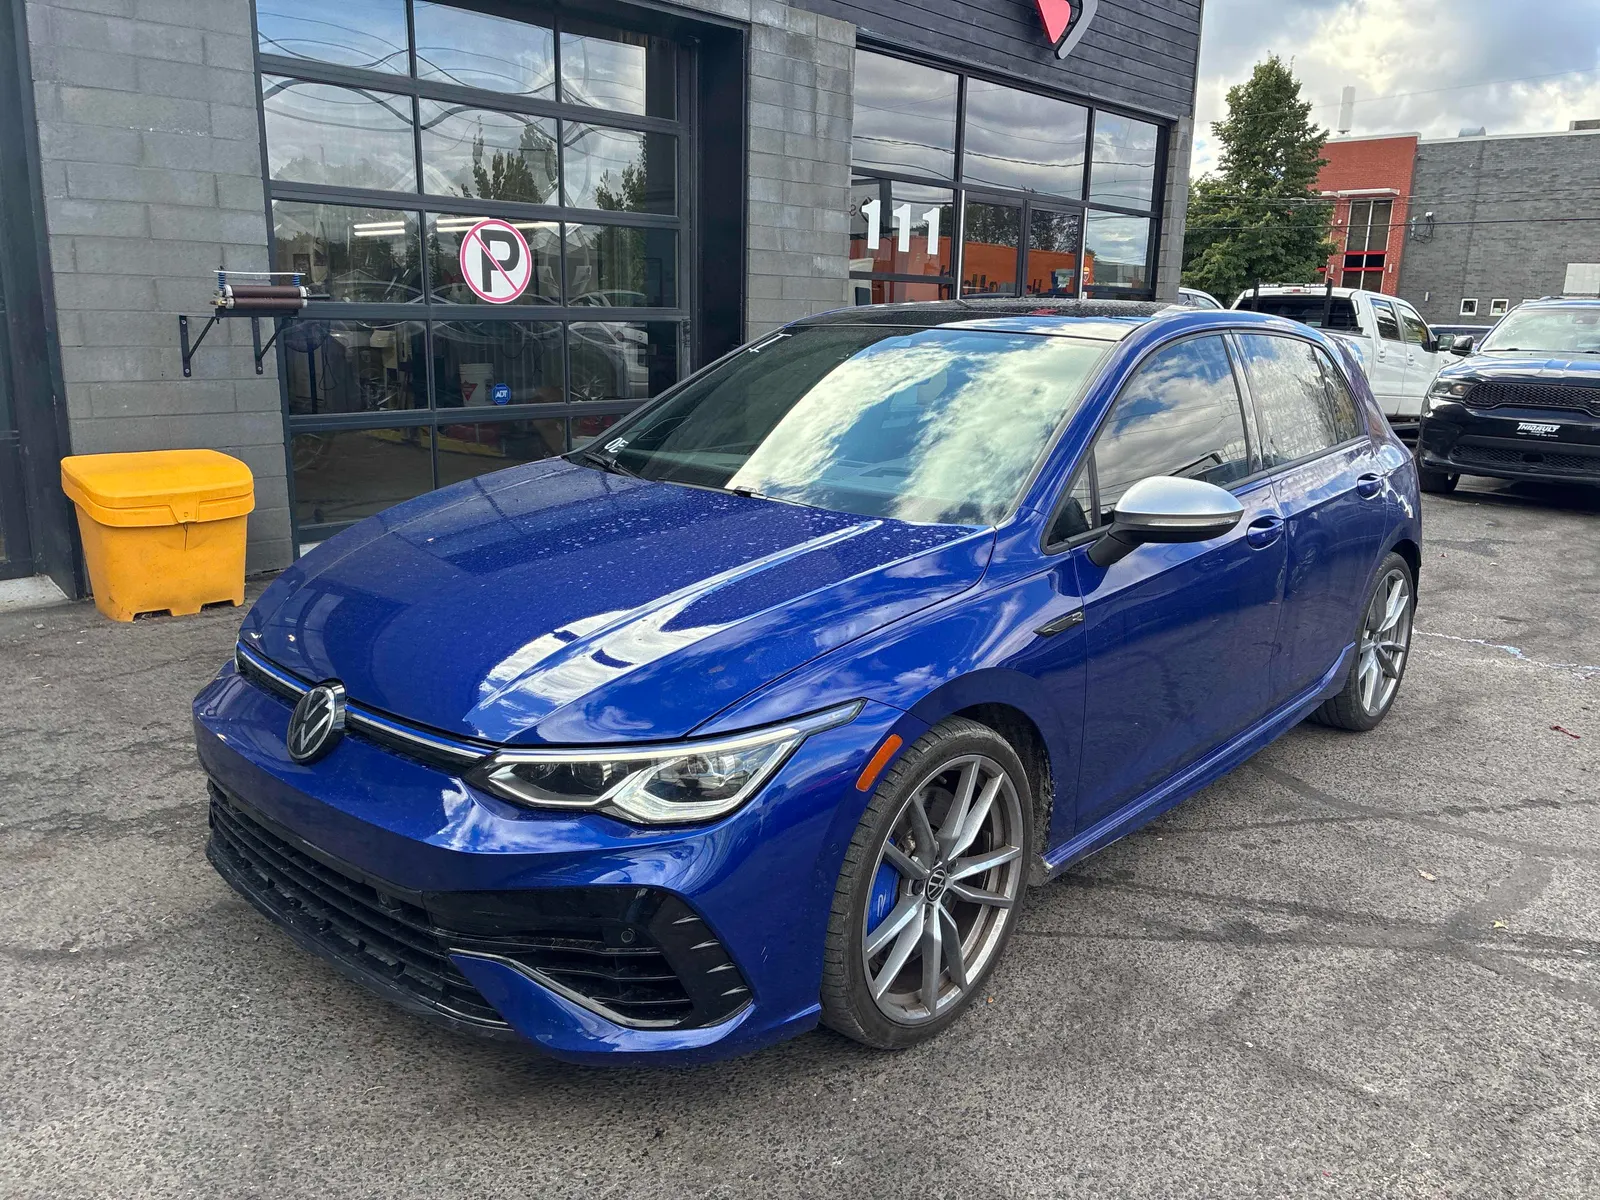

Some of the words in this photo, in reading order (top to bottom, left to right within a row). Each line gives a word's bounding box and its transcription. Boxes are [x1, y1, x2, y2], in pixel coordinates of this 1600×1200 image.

[861, 199, 940, 255] 111
[480, 229, 520, 292] P
[495, 390, 508, 398] ADT
